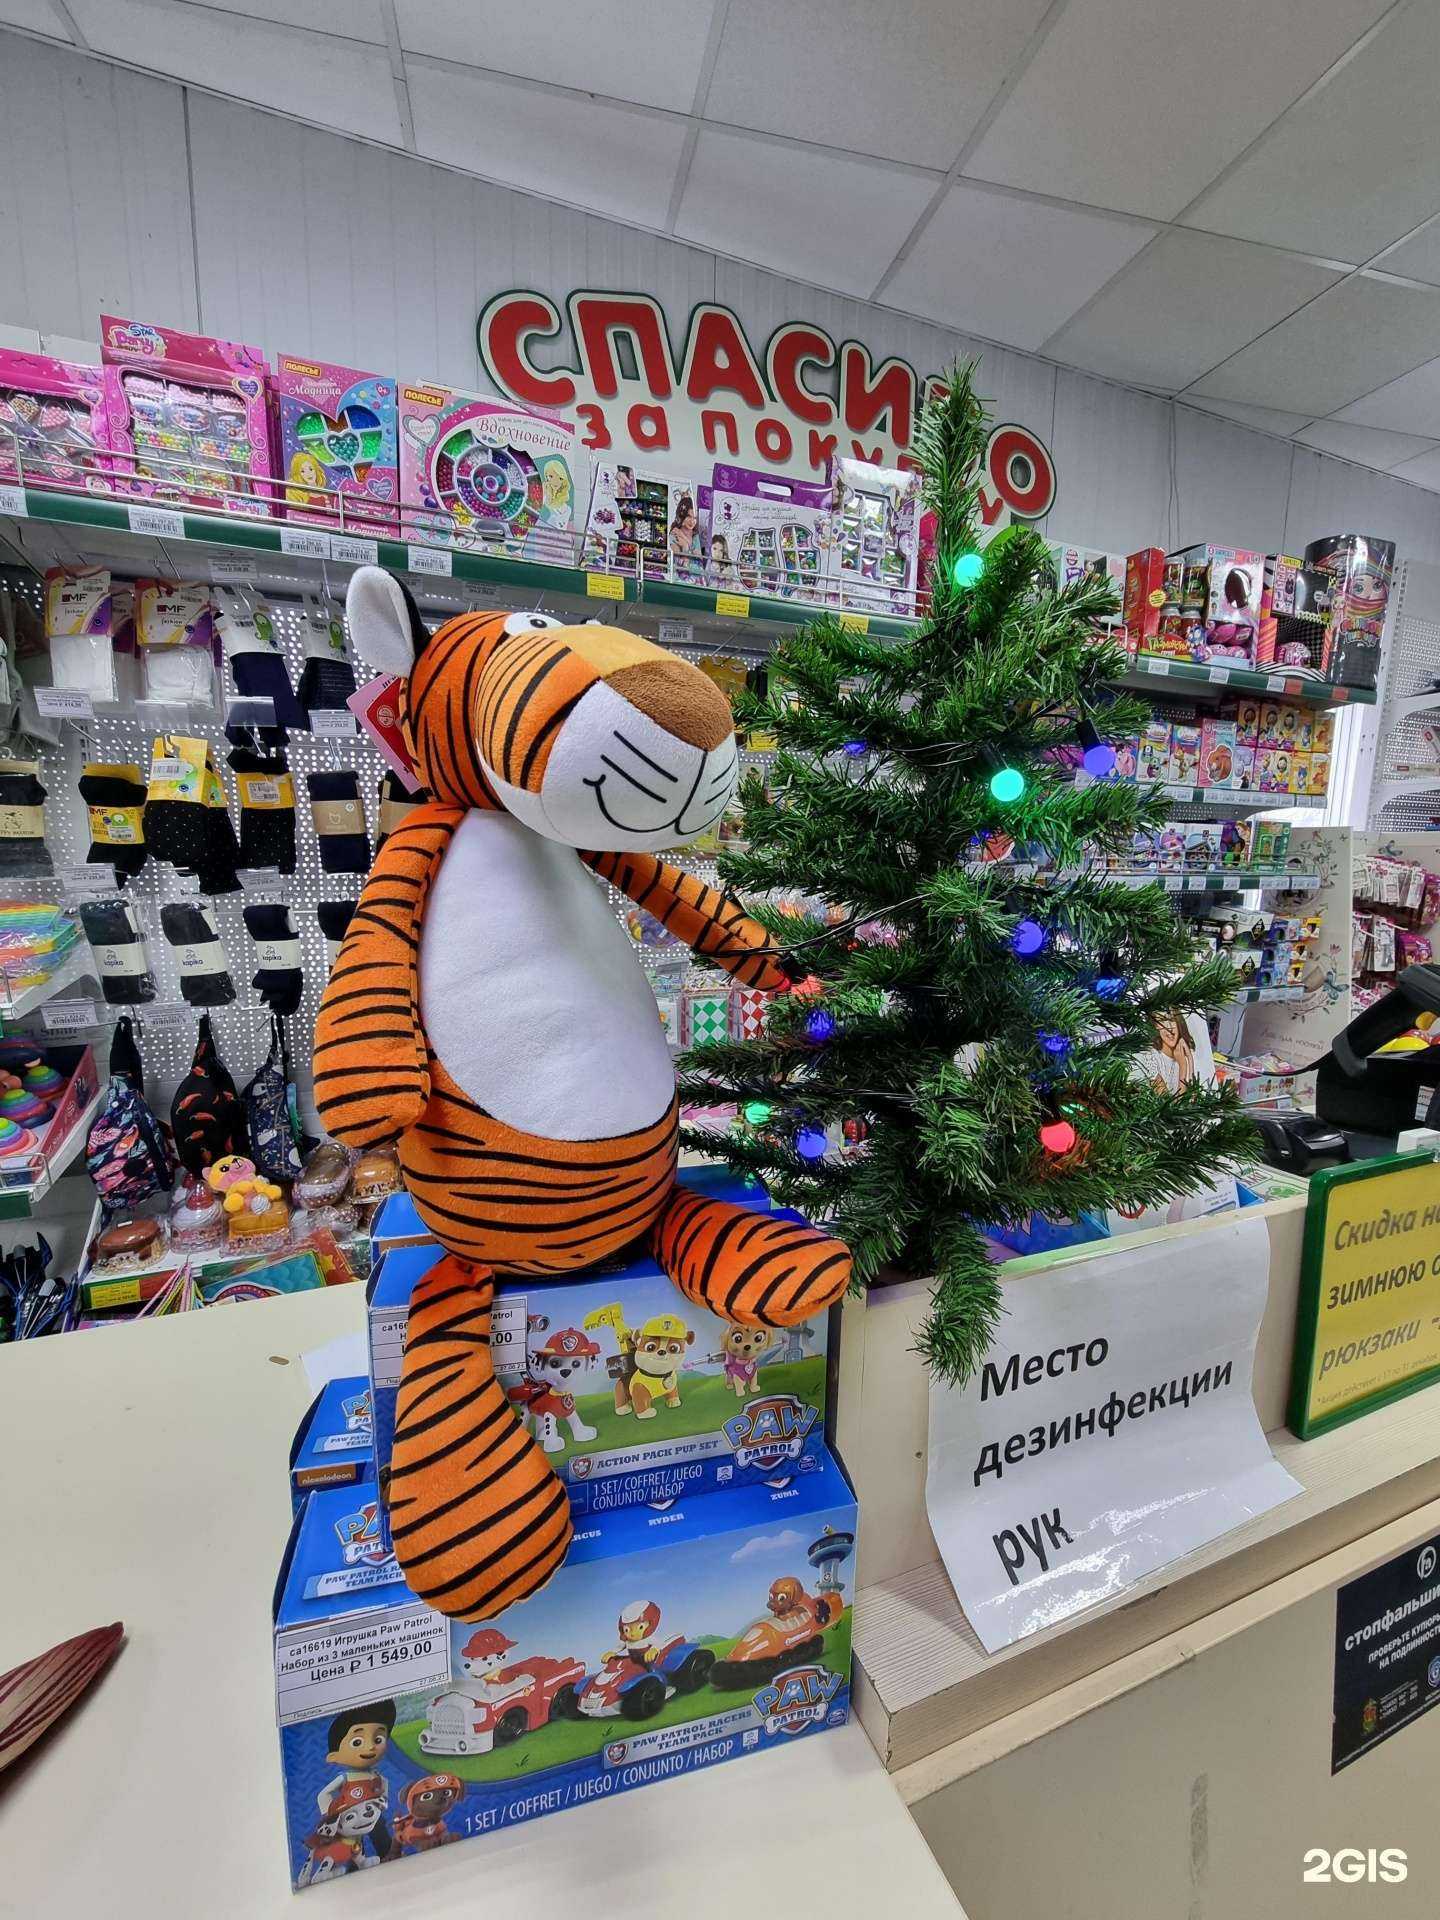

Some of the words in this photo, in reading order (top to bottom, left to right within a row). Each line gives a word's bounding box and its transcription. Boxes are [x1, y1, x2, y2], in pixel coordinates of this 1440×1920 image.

[285, 361, 320, 376] ПОЛЕСЬЕ
[288, 382, 342, 397] Модница
[405, 391, 443, 405] ПОЛЕСЬЕ
[482, 294, 1054, 516] СПАСИО
[479, 419, 571, 451] Вдохновение
[701, 408, 1004, 527] покуу
[104, 959, 124, 967] kapika
[182, 959, 204, 967] kapika
[262, 954, 282, 963] kapika
[1334, 1208, 1418, 1251] Скидка
[1327, 1260, 1426, 1310] зимнюю
[490, 1311, 513, 1321] atrol
[1318, 1319, 1421, 1381] рюкзаки
[980, 1337, 1109, 1402] Место
[722, 1404, 820, 1449] PAW
[973, 1361, 1234, 1487] дезинфекции
[597, 1455, 641, 1469] ACTION
[643, 1448, 673, 1461] PACK
[675, 1444, 697, 1456] PUP
[699, 1440, 719, 1453] SET
[743, 1443, 796, 1461] PATROL
[594, 1484, 600, 1497] 1
[671, 1464, 703, 1484] JUEGO
[651, 1482, 685, 1500] НАБОР
[770, 1489, 800, 1501] ZUMA
[648, 1513, 685, 1527] RYDER
[354, 1543, 381, 1555] PAT
[572, 1529, 602, 1542] RCUS
[992, 1507, 1074, 1585] рук
[325, 1575, 348, 1585] PAW
[350, 1567, 389, 1579] PATROL
[345, 1576, 375, 1587] TEAM
[334, 1629, 378, 1646] Игрушка
[380, 1623, 401, 1636] Paw
[403, 1614, 433, 1629] Patrol
[281, 1658, 315, 1672] Набор
[317, 1655, 330, 1663] из
[332, 1650, 339, 1659] 3
[341, 1638, 397, 1657] маленьких
[399, 1626, 444, 1643] машинок
[310, 1665, 345, 1682] Цена
[367, 1655, 374, 1668] 1
[381, 1640, 432, 1665] 549,00
[1368, 1630, 1410, 1664] ПРОВЕРЬТЕ
[1379, 1655, 1390, 1670] НА
[752, 1672, 844, 1717] PAW
[632, 1736, 659, 1749] PAW
[660, 1724, 707, 1741] PATROL
[708, 1710, 751, 1727] RACERS
[772, 1708, 820, 1727] PATROL
[657, 1735, 692, 1751] TEAM
[692, 1726, 724, 1743] PACK
[465, 1817, 472, 1833] 1
[475, 1810, 497, 1831] SET
[508, 1788, 563, 1820] COFFRET
[573, 1773, 612, 1801] JUEGO
[622, 1756, 684, 1787] CONJUNTO
[694, 1739, 734, 1765] НАБОР
